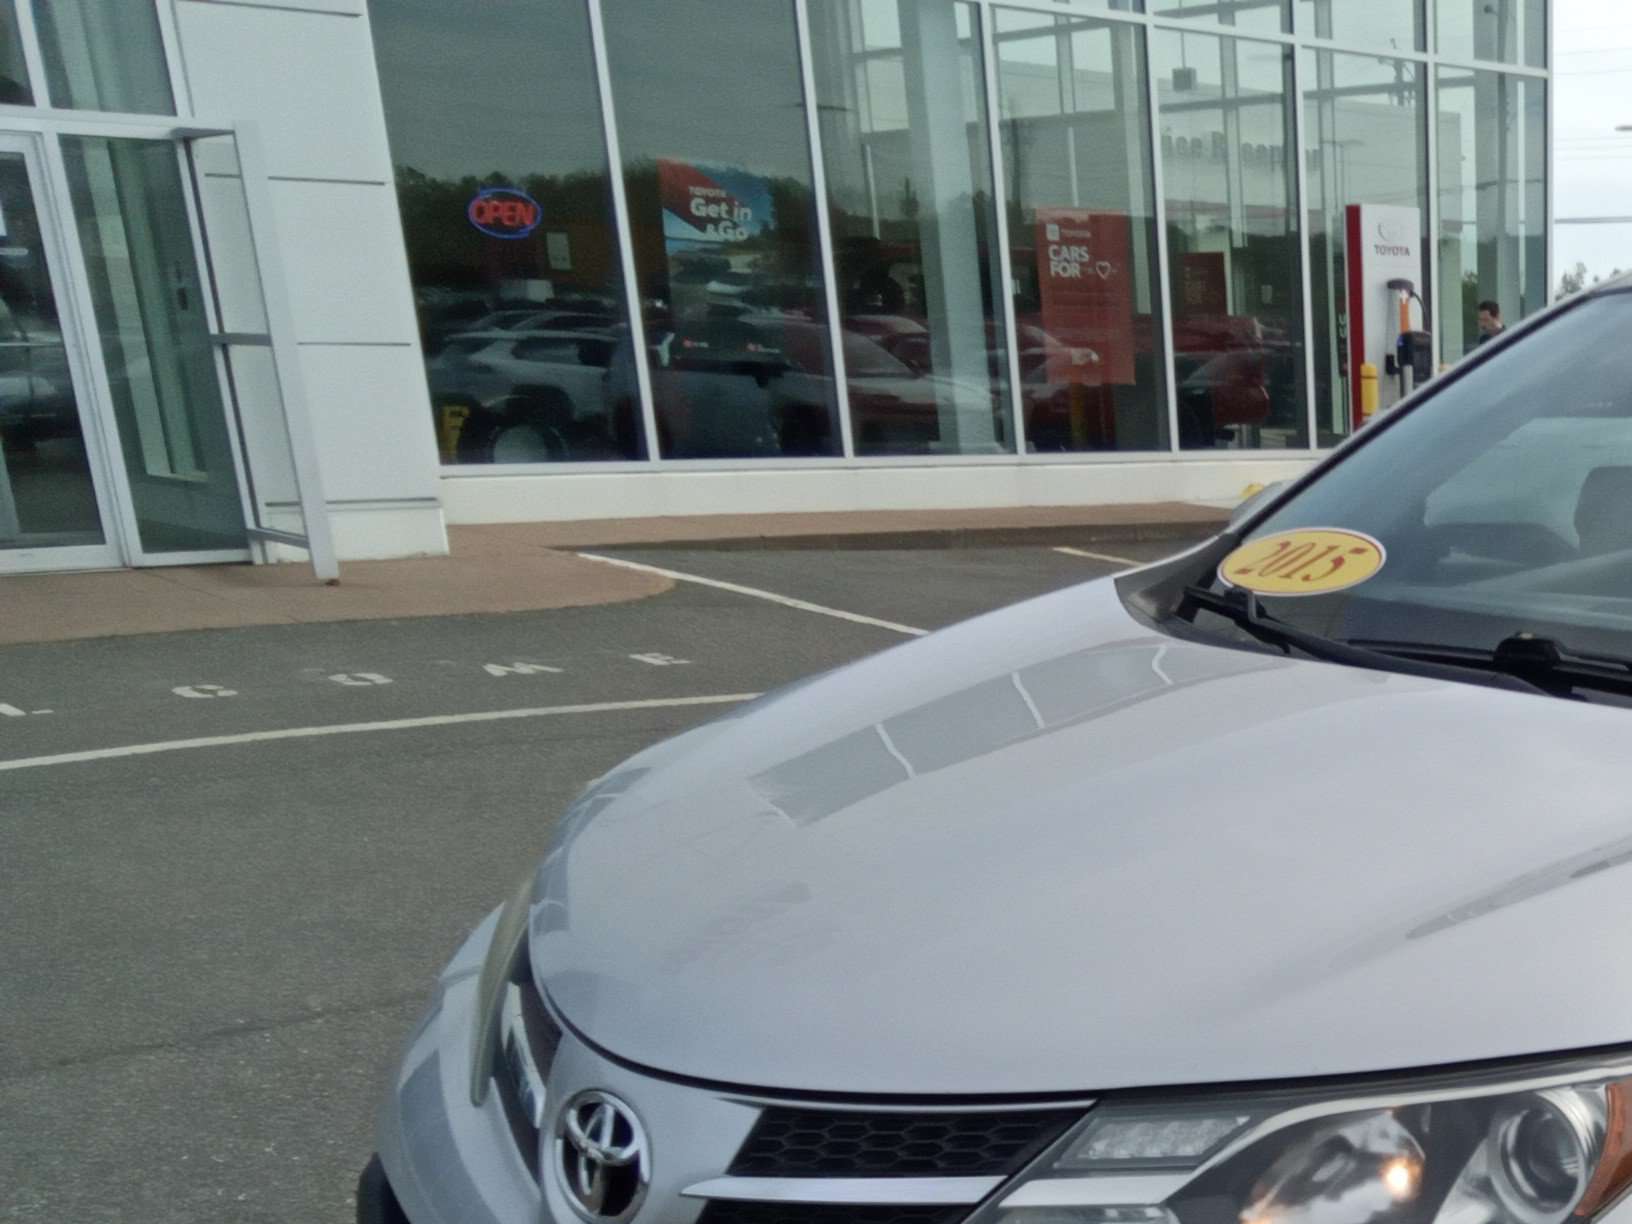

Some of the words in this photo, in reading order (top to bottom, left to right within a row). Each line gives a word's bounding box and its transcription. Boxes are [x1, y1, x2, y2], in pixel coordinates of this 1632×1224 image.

[473, 200, 536, 227] OPEN
[690, 197, 729, 219] Get
[733, 201, 752, 222] in
[1048, 244, 1089, 262] CARS
[1050, 260, 1081, 278] FOR
[1250, 540, 1345, 582] 2015
